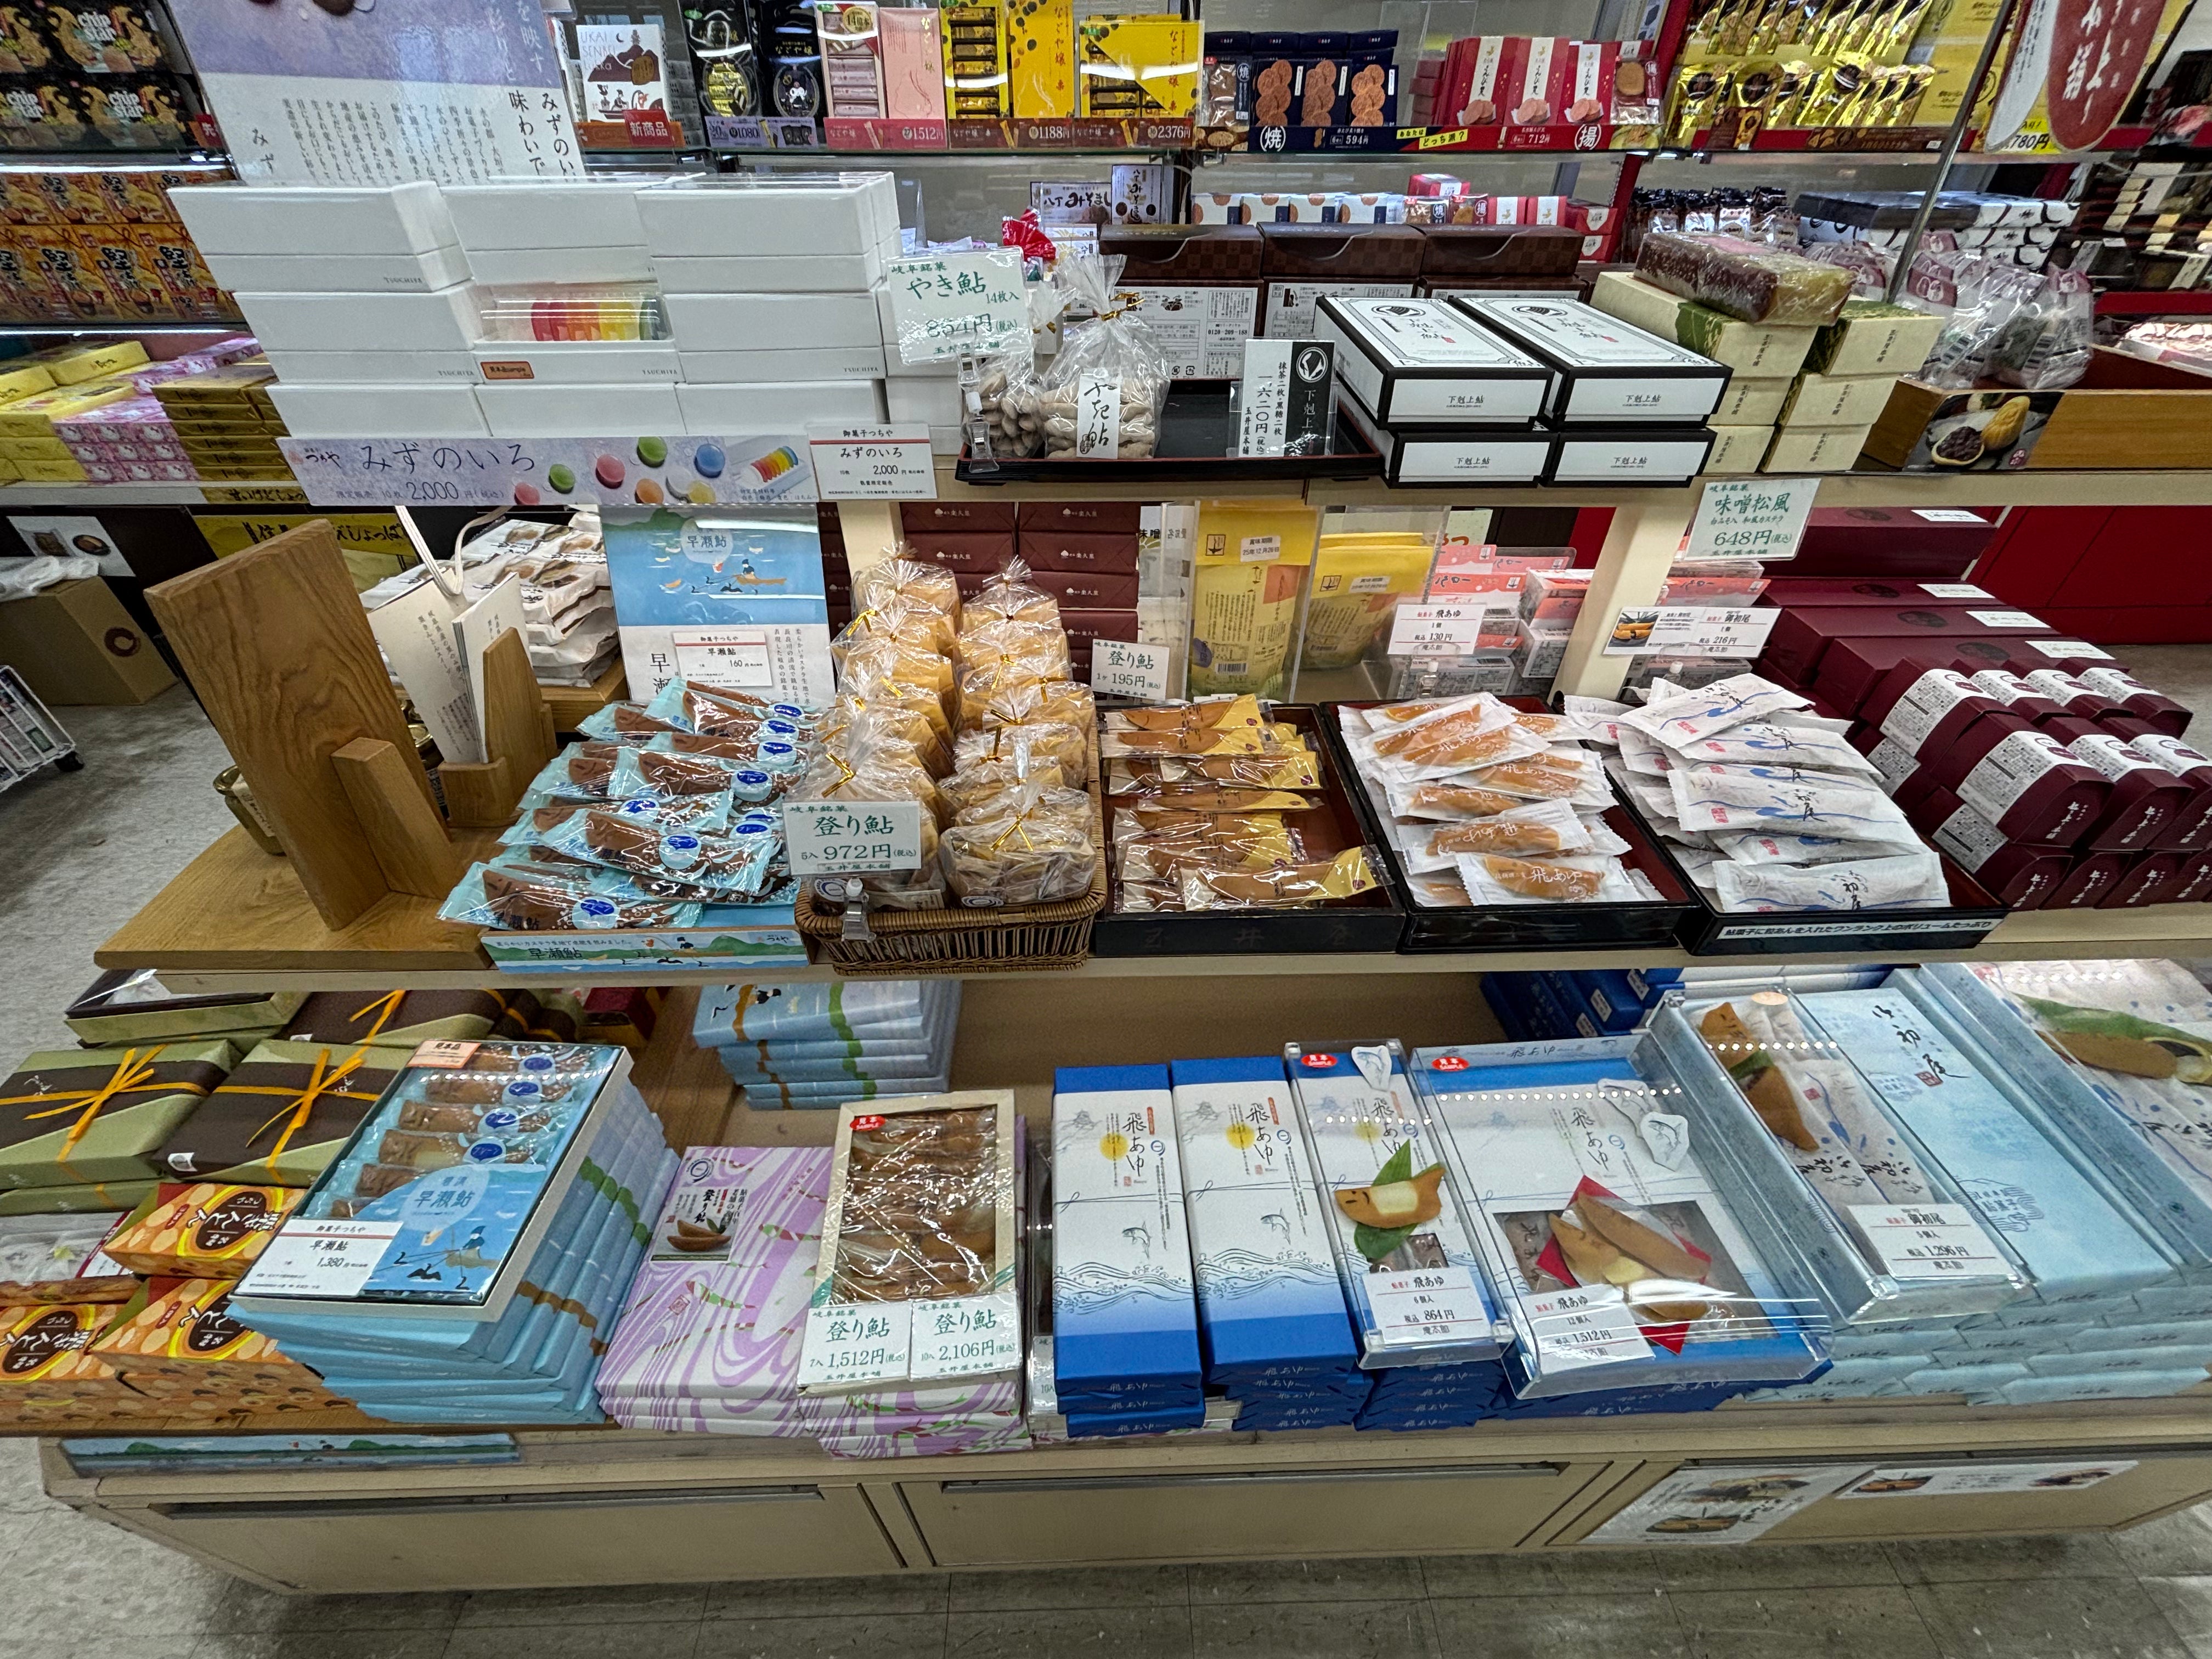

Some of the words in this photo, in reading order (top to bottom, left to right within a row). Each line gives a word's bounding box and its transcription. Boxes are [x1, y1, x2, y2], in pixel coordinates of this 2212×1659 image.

[109, 90, 139, 106] chip
[629, 121, 668, 137] 新商品
[891, 261, 947, 274] 岐阜銘菓
[906, 271, 986, 300] やき鮎
[986, 291, 1020, 304] 14枚入
[842, 429, 894, 438] 御菓子つちや
[360, 442, 535, 474] みずのいろ
[839, 447, 904, 458] みずのいろ
[873, 465, 899, 476] 2,000
[406, 482, 459, 500] 2,000
[1708, 484, 1749, 492] 岐阜銘菓
[1714, 493, 1791, 515] 味噌松風
[687, 535, 727, 549] 早瀬鮎
[1714, 529, 1772, 546] 648円
[1435, 609, 1461, 618] 飛あゆ
[1429, 633, 1453, 641] 130円
[1713, 636, 1738, 645] 216円
[707, 647, 736, 656] 早瀬鮎
[730, 659, 743, 668] 160
[1108, 651, 1155, 670] 登り鮎
[1111, 673, 1146, 688] 195円
[789, 804, 848, 814] 岐阜銘菓
[813, 815, 894, 837] 登り鮎
[823, 843, 891, 860] 972円
[1531, 866, 1581, 884] 飛あゆ
[529, 947, 583, 960] 早瀬鮎
[1245, 1103, 1274, 1165] 飛あゆ
[1572, 1107, 1610, 1169] 飛あゆ
[1122, 1113, 1147, 1177] 飛あゆ
[414, 1189, 476, 1207] 早瀬鮎
[309, 1240, 349, 1251] 早瀬鮎
[317, 1257, 345, 1268] 1,380
[1413, 1276, 1444, 1289] 飛あゆ
[1558, 1296, 1589, 1310] 飛あゆ
[812, 1309, 856, 1318] 岐阜銘菓
[1424, 1308, 1455, 1321] 864円
[934, 1308, 997, 1336] 登り鮎
[825, 1316, 890, 1343] 登り鮎
[939, 1339, 995, 1361] 2,106円
[828, 1347, 885, 1368] 1,512円
